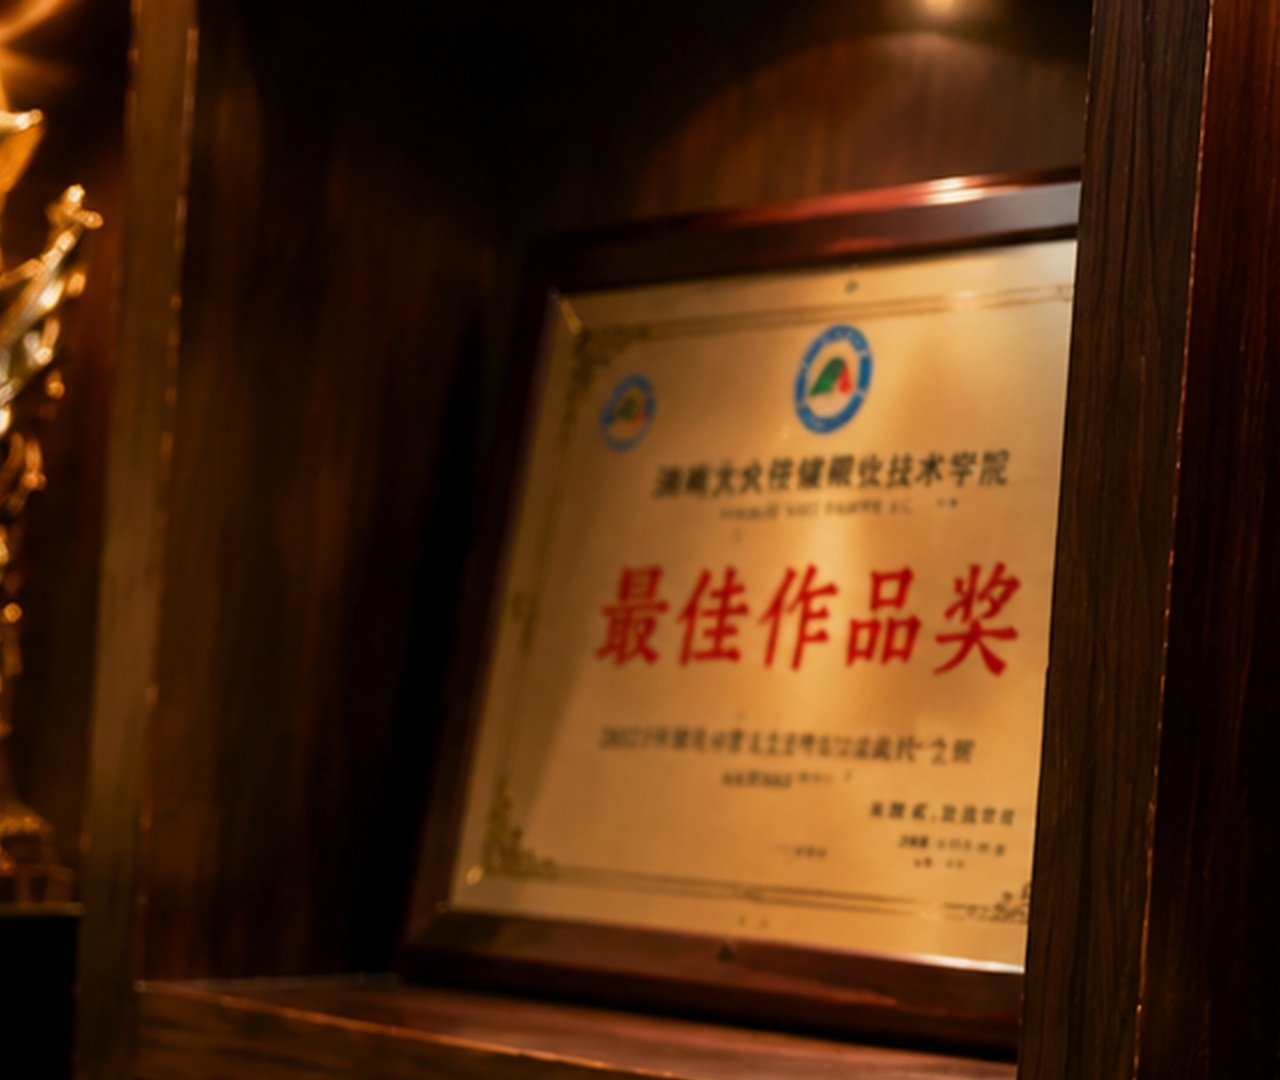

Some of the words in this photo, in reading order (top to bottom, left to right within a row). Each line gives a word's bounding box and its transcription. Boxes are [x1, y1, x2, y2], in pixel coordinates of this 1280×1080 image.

[596, 561, 1021, 676] 最佳作品奖
